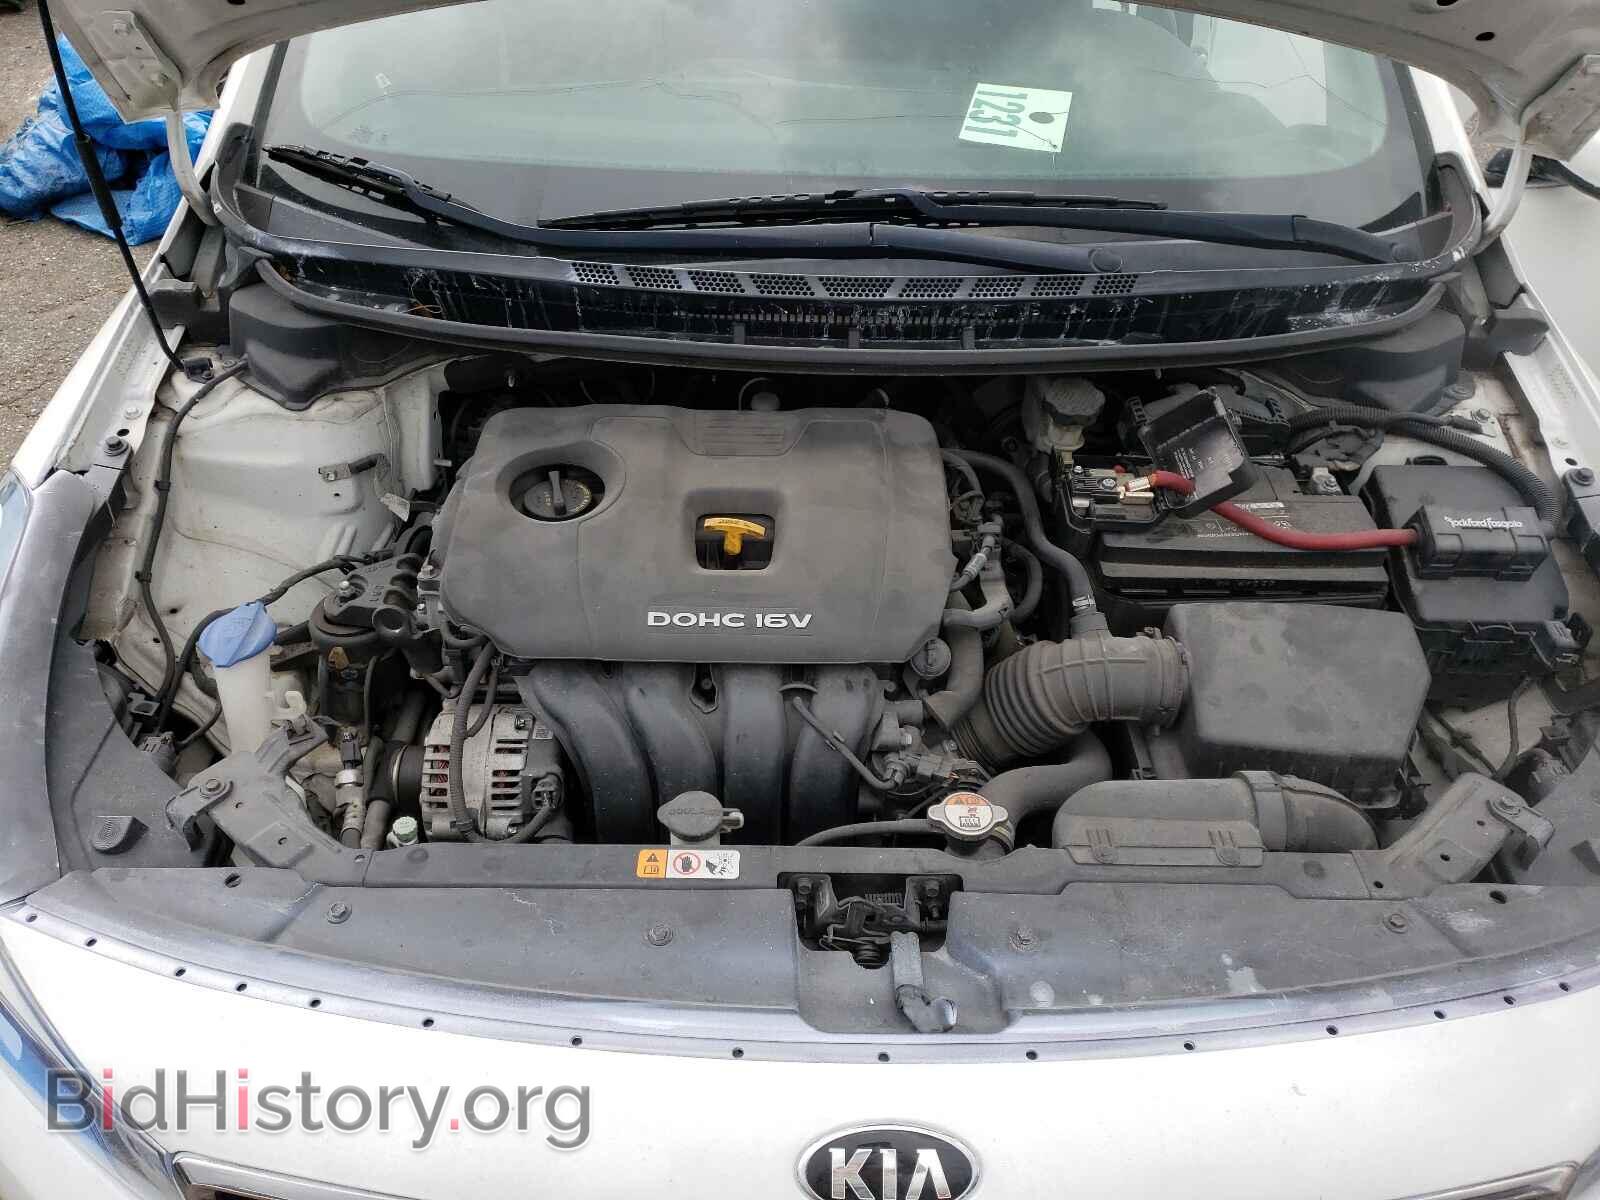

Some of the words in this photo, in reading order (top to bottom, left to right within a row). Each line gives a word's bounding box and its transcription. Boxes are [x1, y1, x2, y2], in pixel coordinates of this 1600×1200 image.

[965, 90, 1028, 138] 1231
[647, 611, 745, 628] DOHC
[755, 613, 813, 629] 16V
[829, 1147, 952, 1200] KIA
